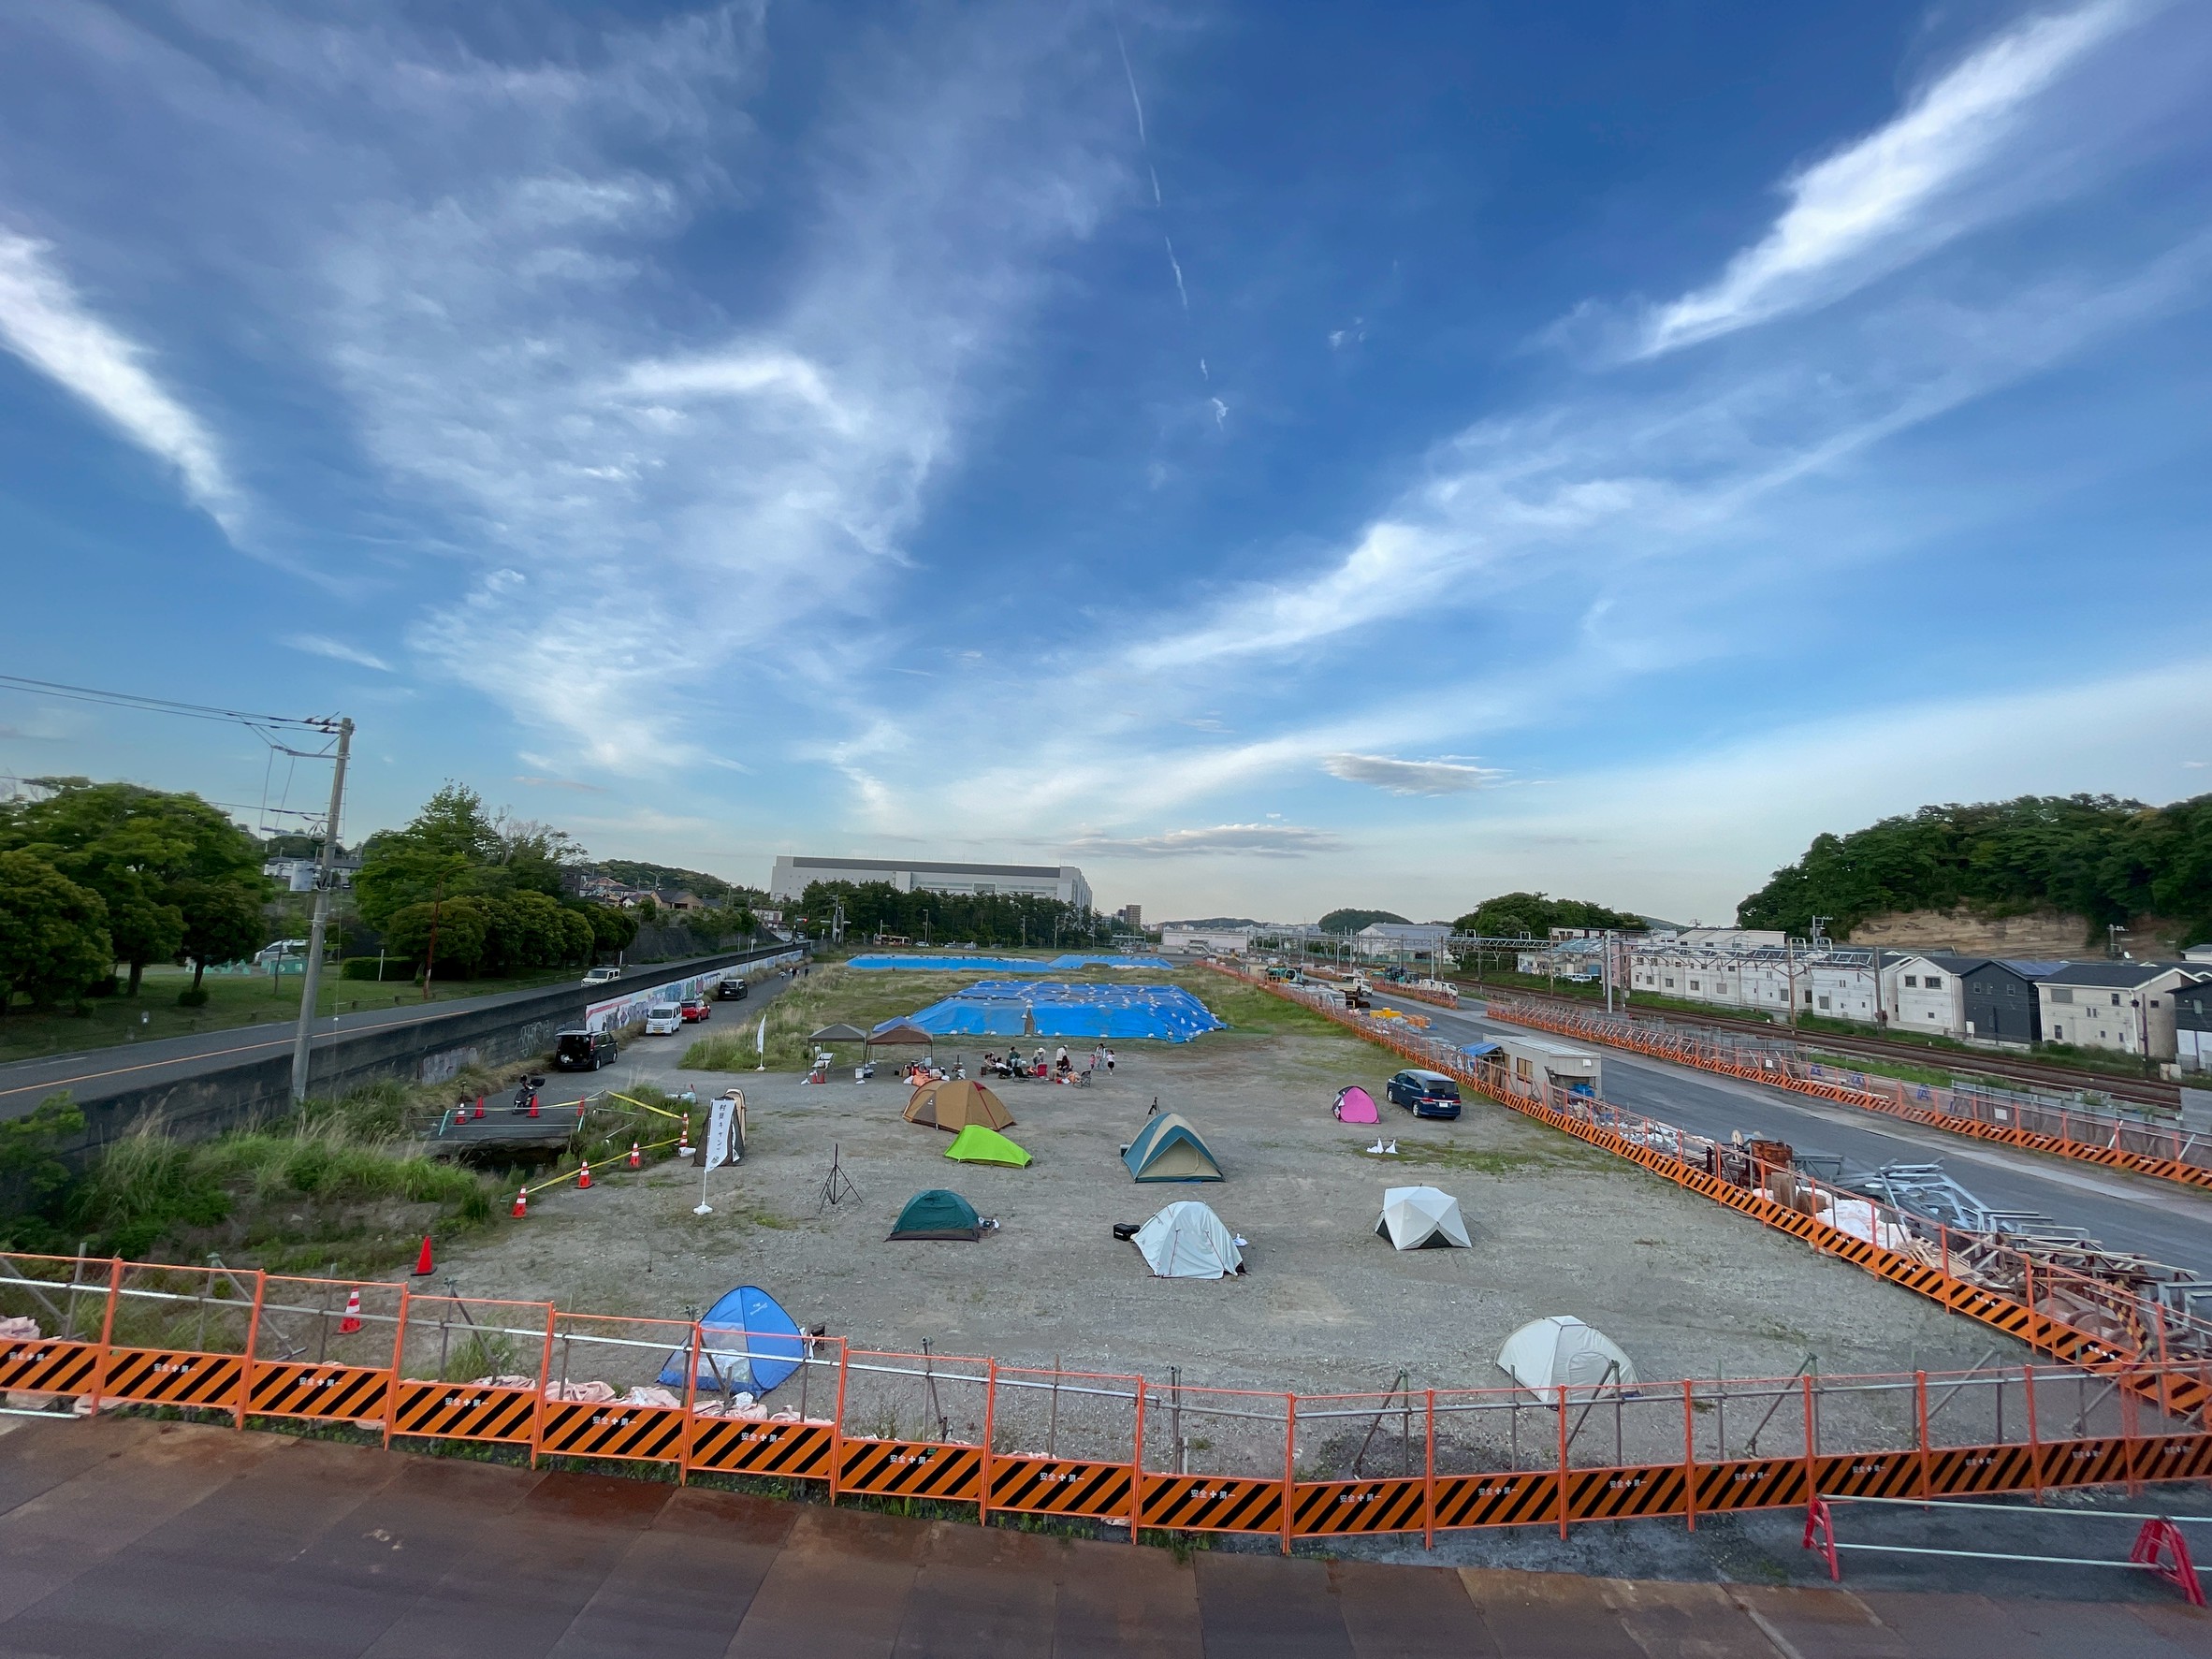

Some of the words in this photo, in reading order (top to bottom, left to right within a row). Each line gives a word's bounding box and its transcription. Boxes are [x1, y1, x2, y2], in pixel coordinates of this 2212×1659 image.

[592, 1417, 608, 1425] 安全
[741, 1433, 757, 1441] 安全
[890, 1455, 906, 1463] 安全
[1040, 1473, 1056, 1481] 安全
[1190, 1490, 1207, 1498] 安全
[1478, 1487, 1492, 1495] 安全
[1340, 1494, 1355, 1503] 安全
